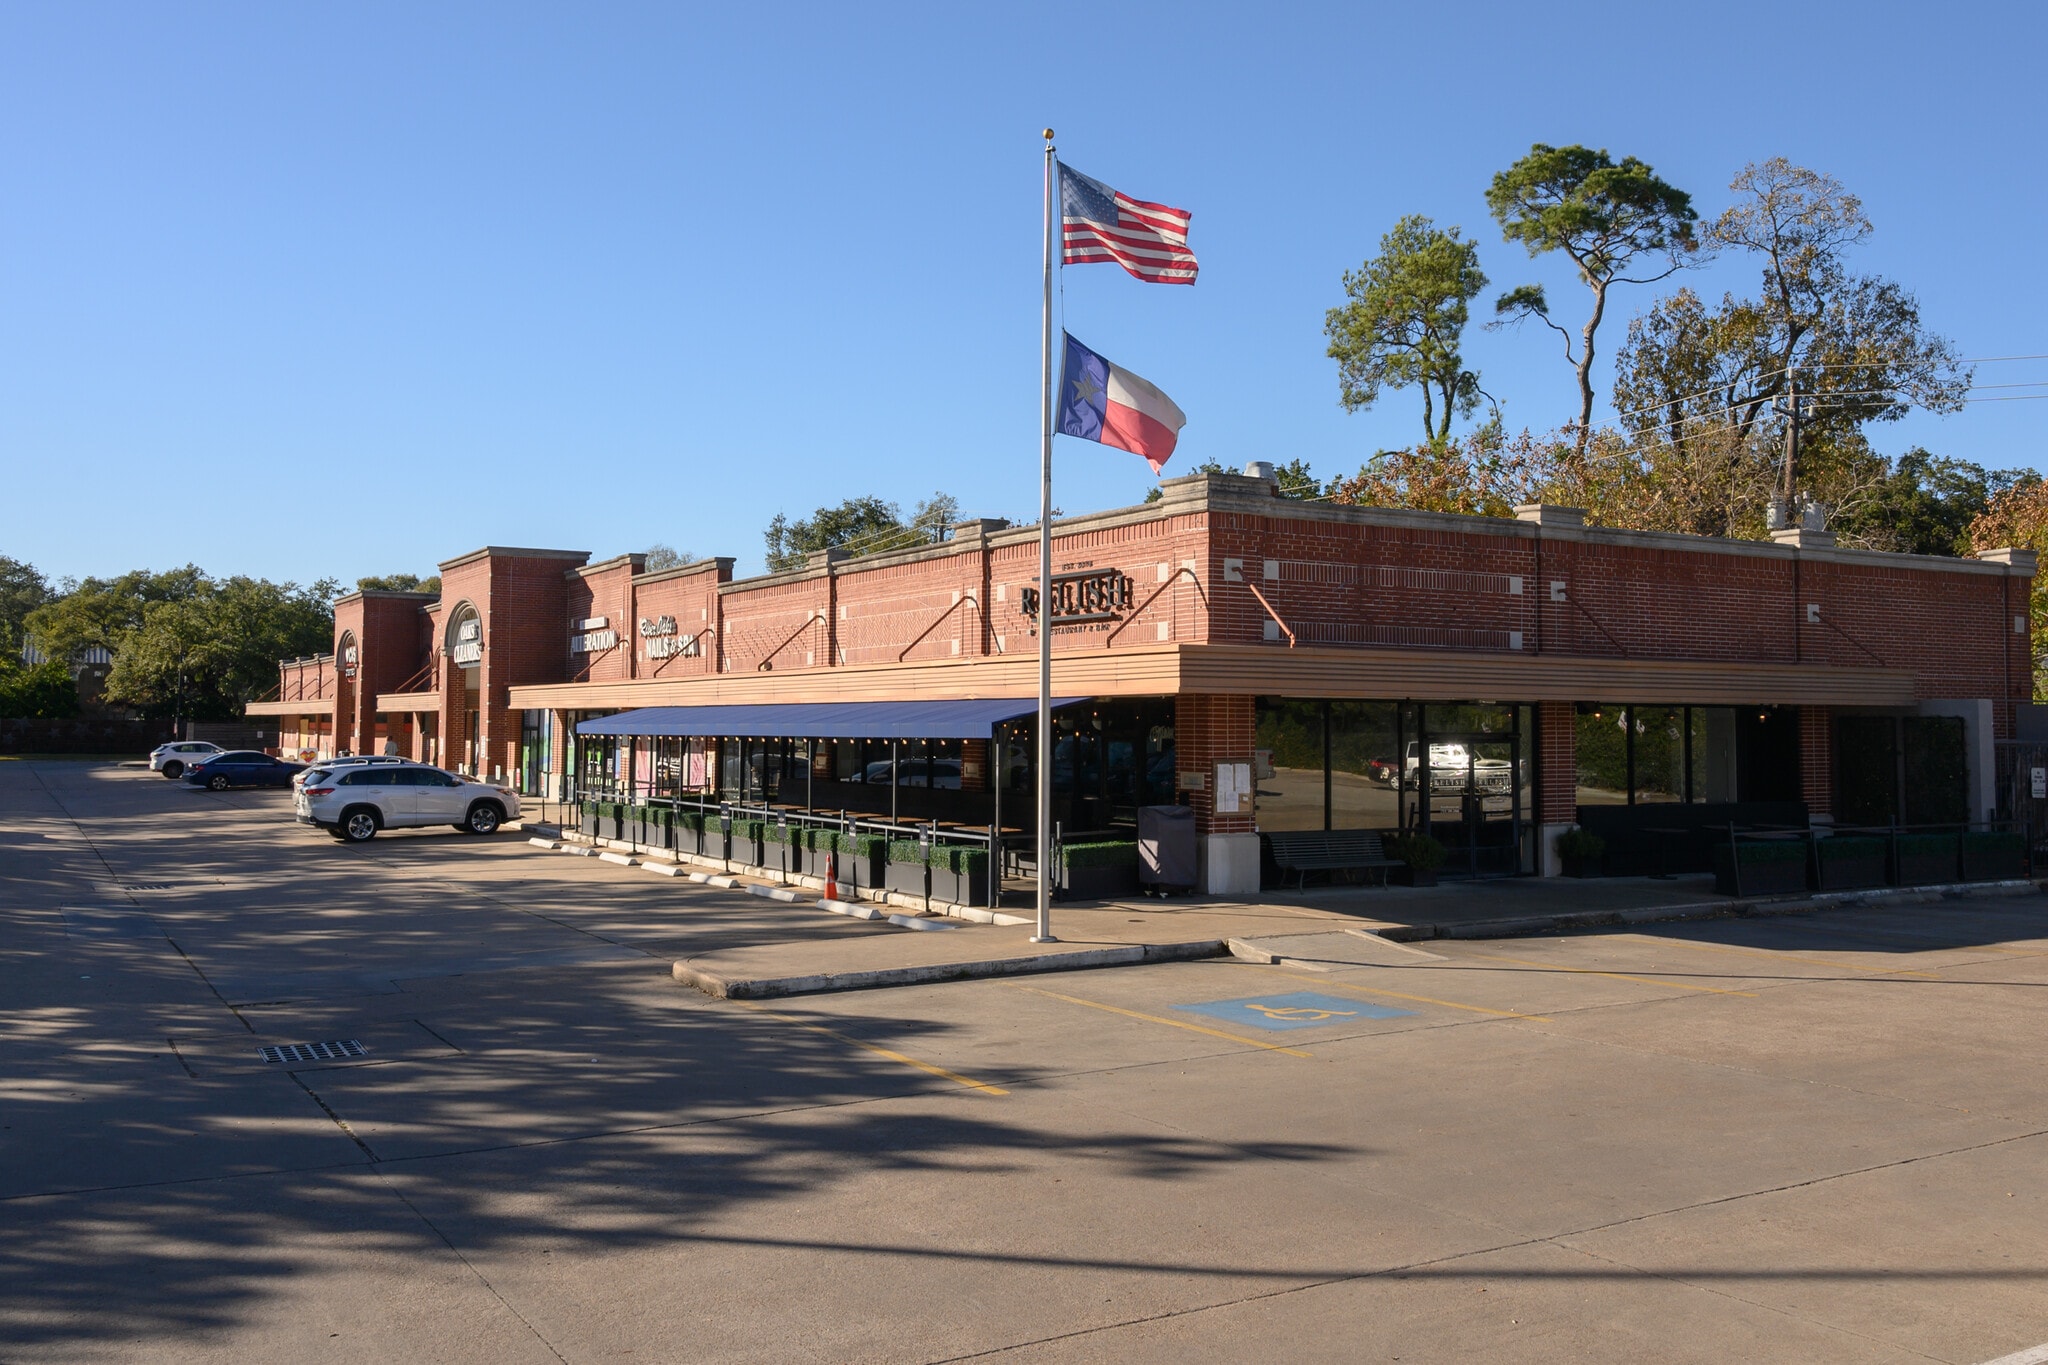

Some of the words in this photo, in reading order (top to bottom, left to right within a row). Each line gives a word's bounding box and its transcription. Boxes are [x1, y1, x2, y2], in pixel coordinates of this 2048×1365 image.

[1021, 574, 1125, 615] RLISH
[572, 630, 616, 653] ALTERATION
[1050, 625, 1087, 636] ESTAURANT
[646, 637, 669, 658] NAILS
[678, 634, 695, 656] SPA
